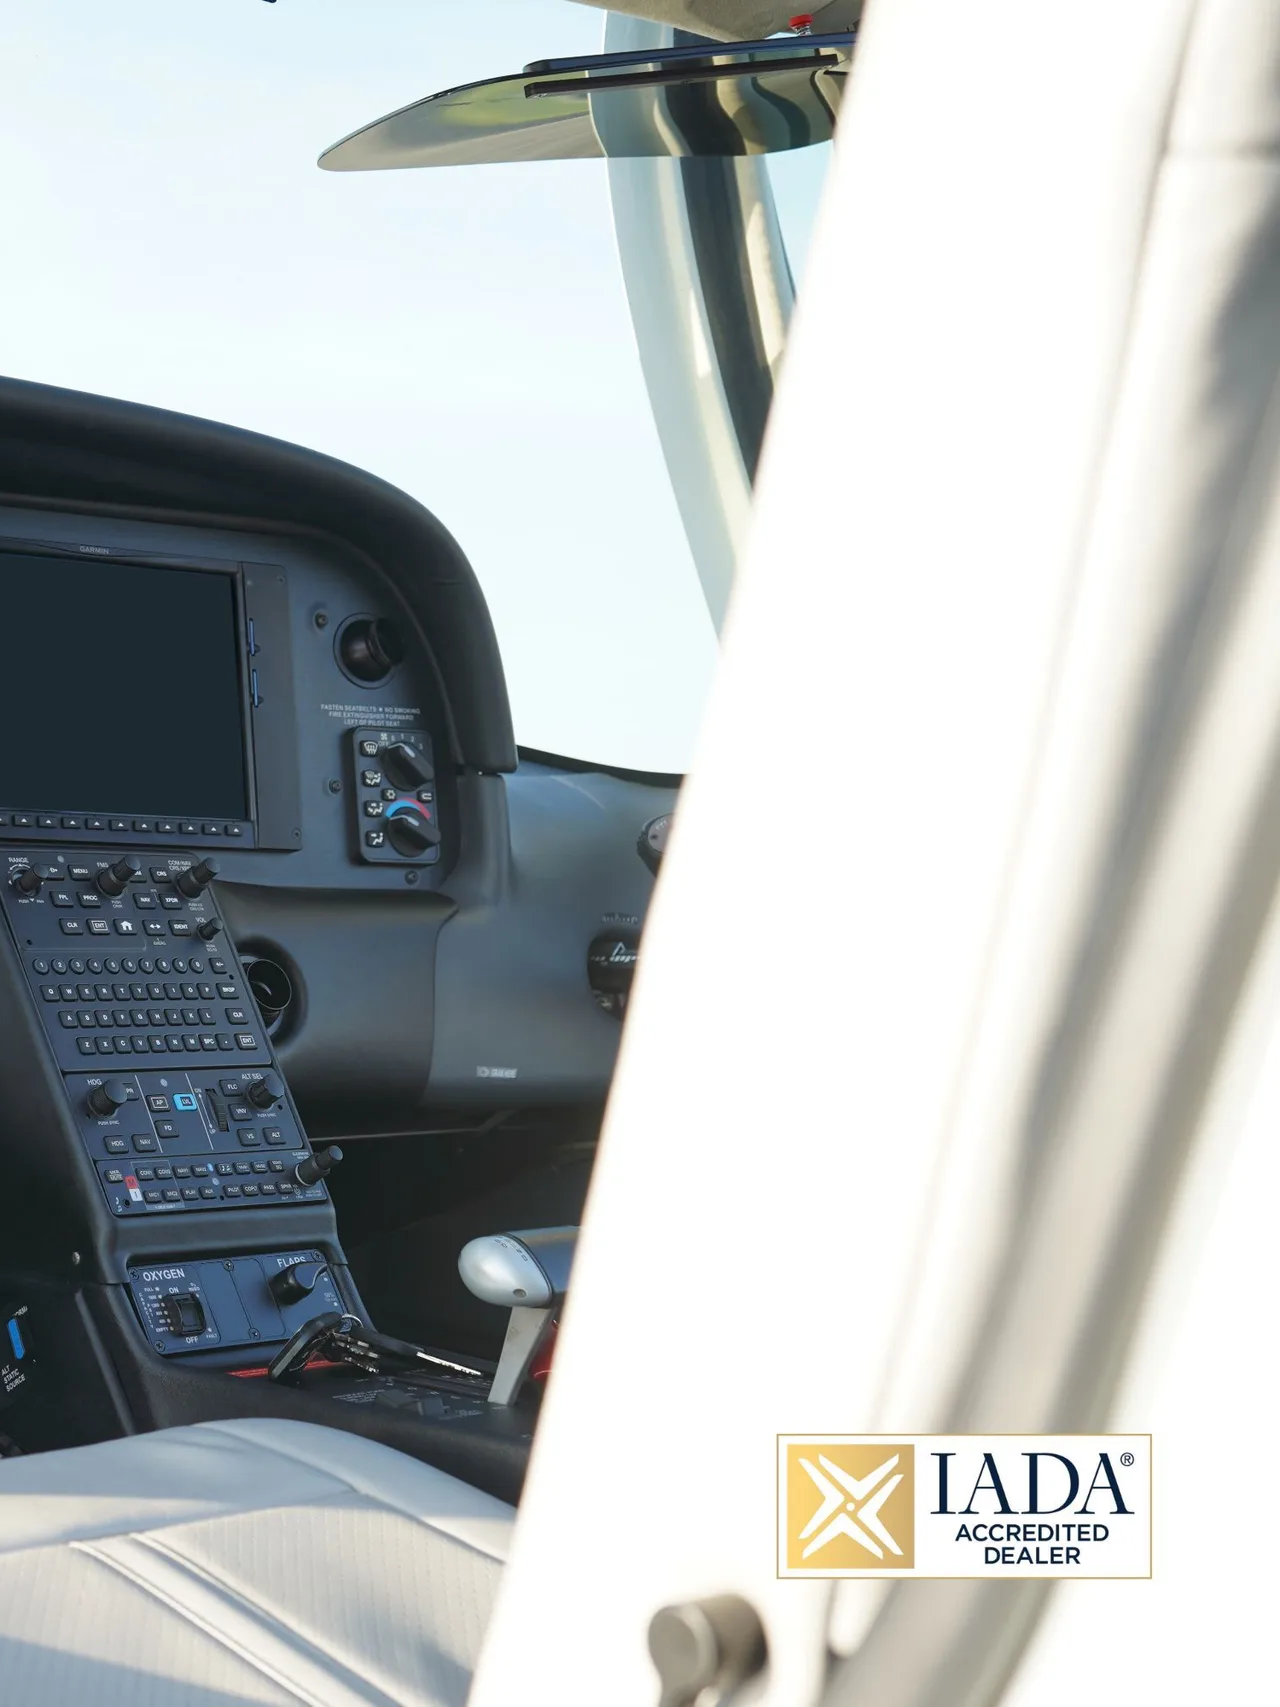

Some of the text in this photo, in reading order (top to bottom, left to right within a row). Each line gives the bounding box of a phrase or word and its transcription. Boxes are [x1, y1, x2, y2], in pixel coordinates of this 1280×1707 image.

[79, 545, 109, 555] GARMIN
[276, 1256, 306, 1267] FLAPS
[143, 1268, 185, 1282] OXYGEN
[168, 1286, 180, 1294] ON
[185, 1336, 199, 1344] OFF
[1, 1364, 10, 1377] ALT
[4, 1368, 20, 1384] STATIC
[6, 1373, 26, 1393] SOURCE
